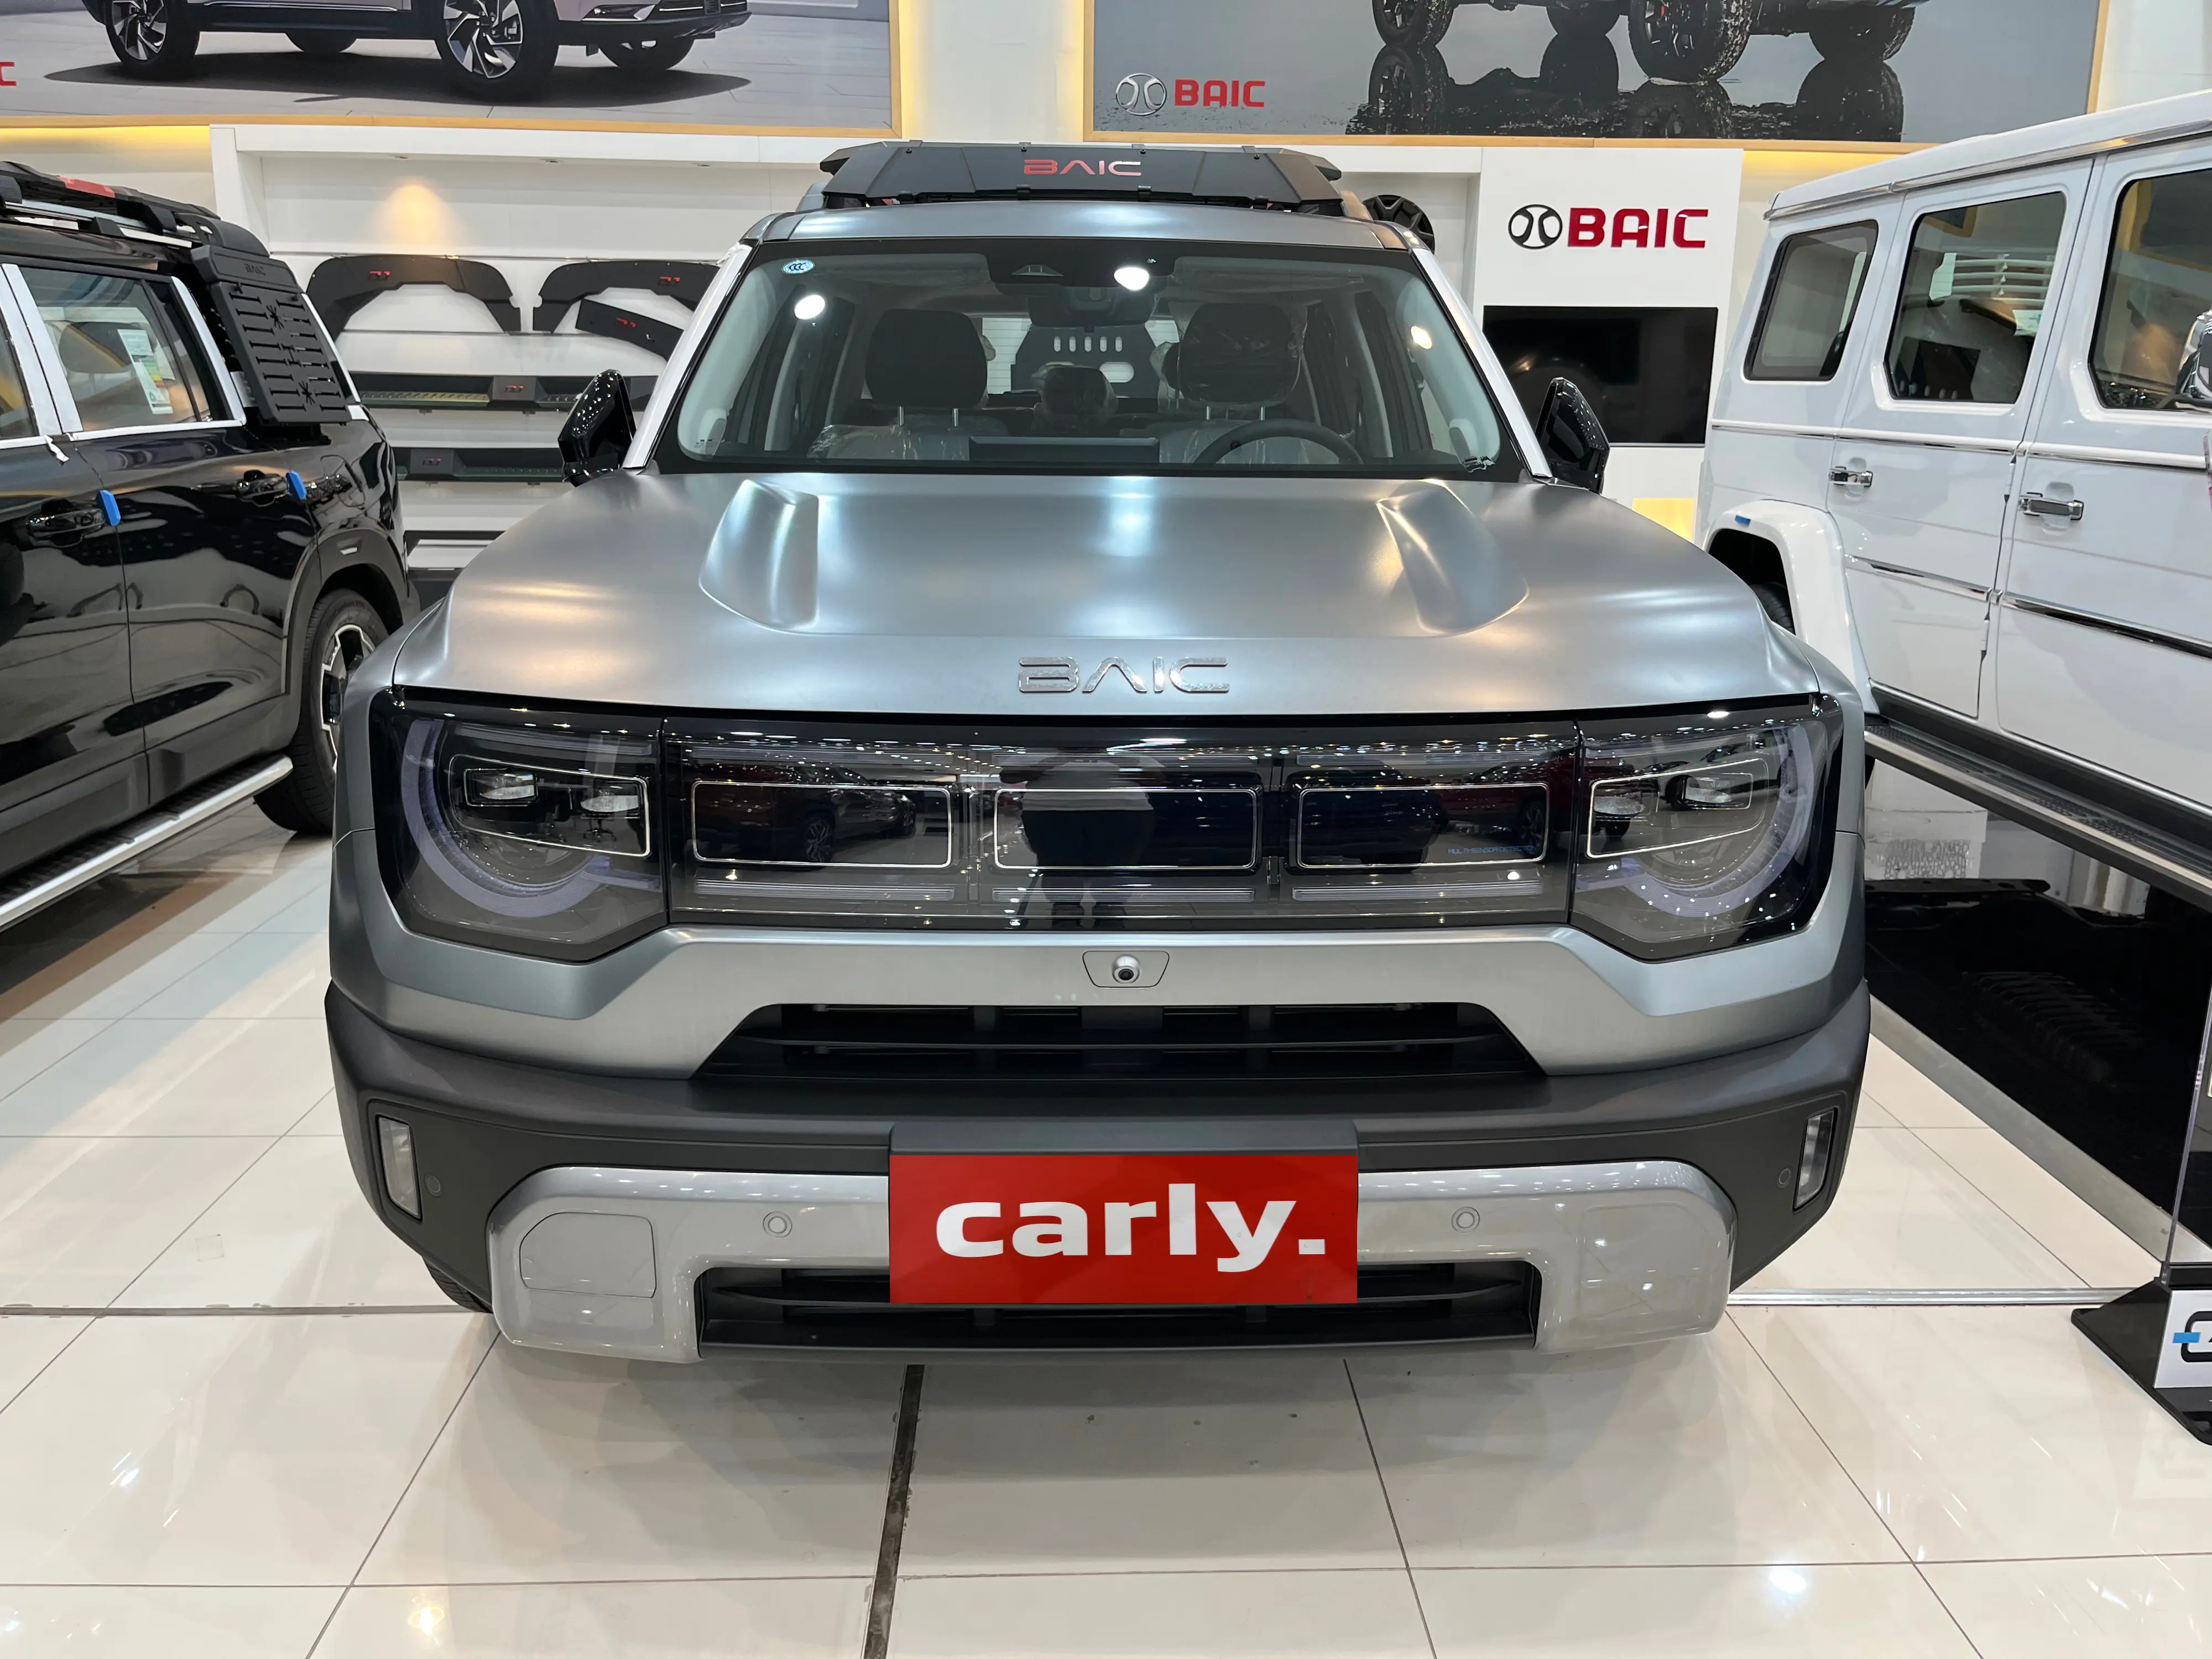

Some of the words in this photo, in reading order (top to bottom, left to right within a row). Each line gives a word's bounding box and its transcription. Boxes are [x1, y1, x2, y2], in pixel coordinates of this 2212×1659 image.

[1175, 80, 1265, 107] BAIC
[1024, 159, 1141, 176] BAIC
[1568, 208, 1708, 248] BAIC
[1019, 657, 1229, 693] BAIC
[936, 1183, 1326, 1272] carly.
